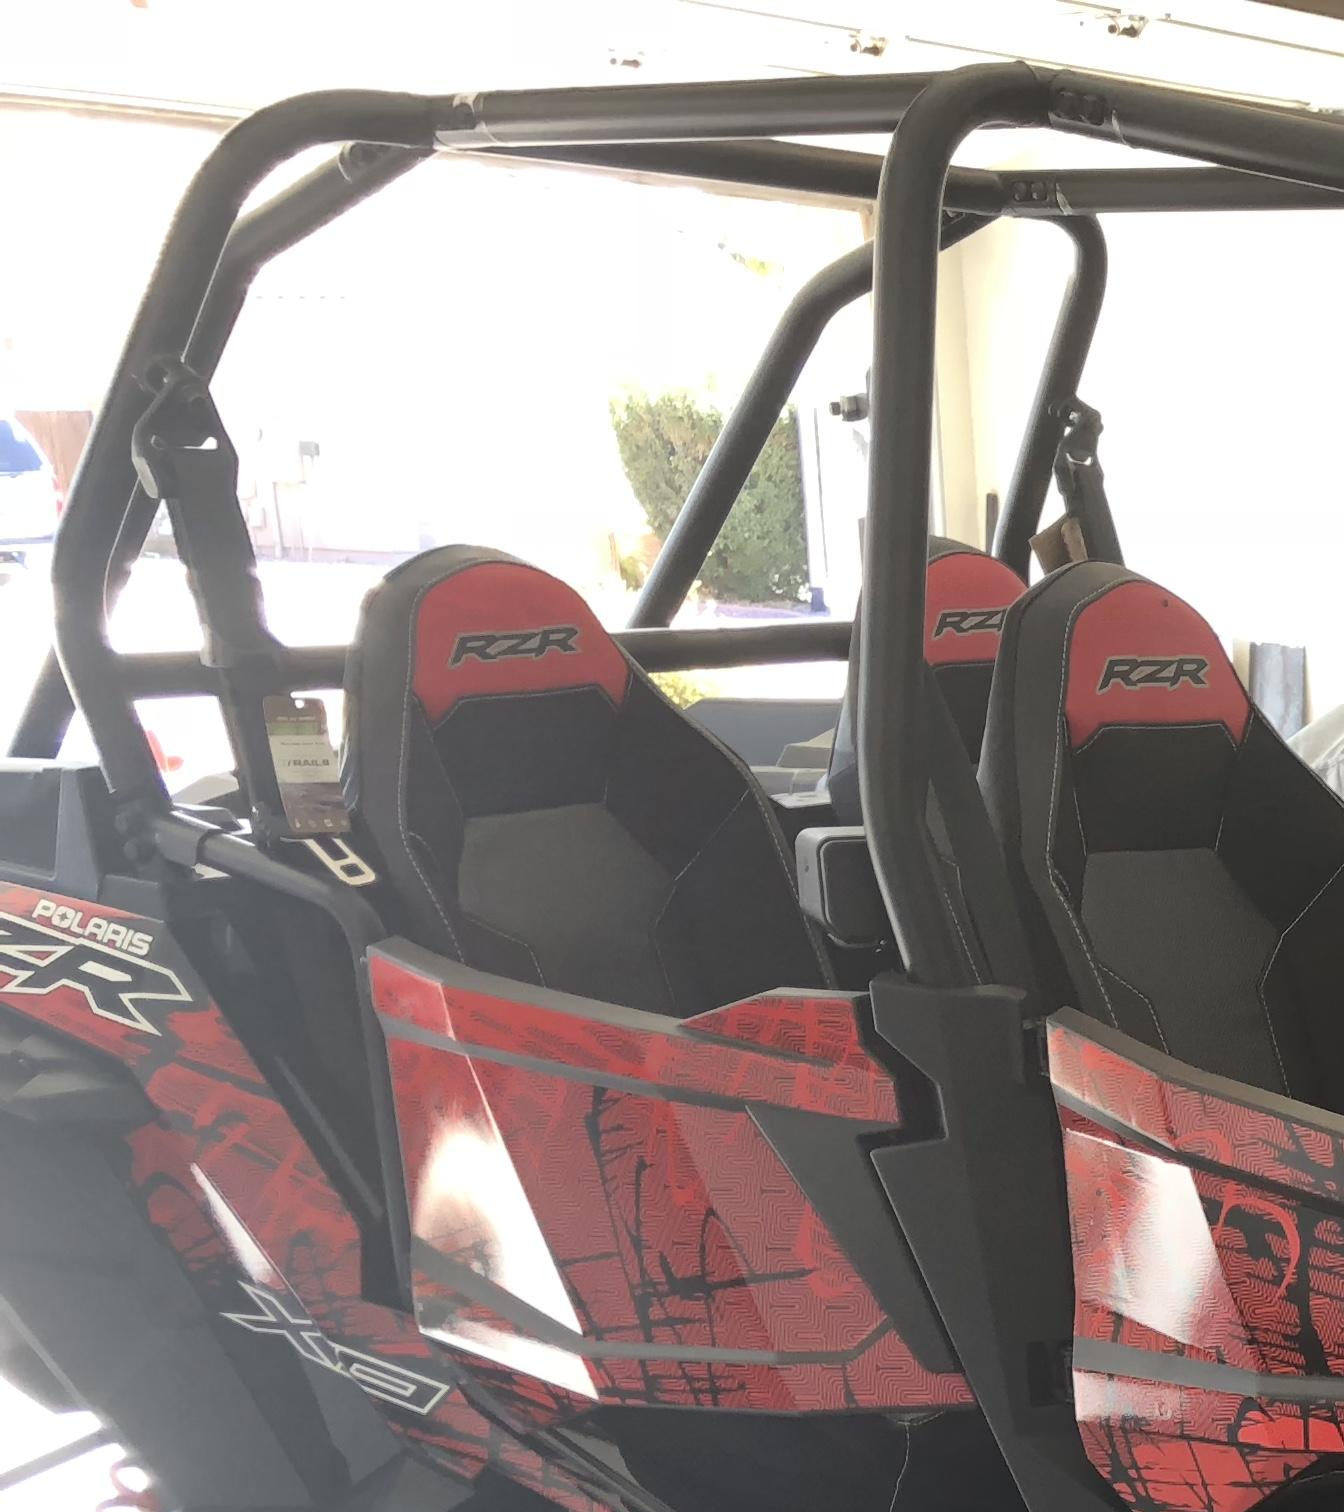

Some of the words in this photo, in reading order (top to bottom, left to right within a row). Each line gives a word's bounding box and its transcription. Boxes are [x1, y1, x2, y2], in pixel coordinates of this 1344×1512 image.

[931, 606, 1008, 641] RZ
[449, 624, 581, 669] RZR
[1096, 655, 1210, 695] RZR
[31, 898, 154, 957] POLARIS
[0, 910, 194, 1037] ZR
